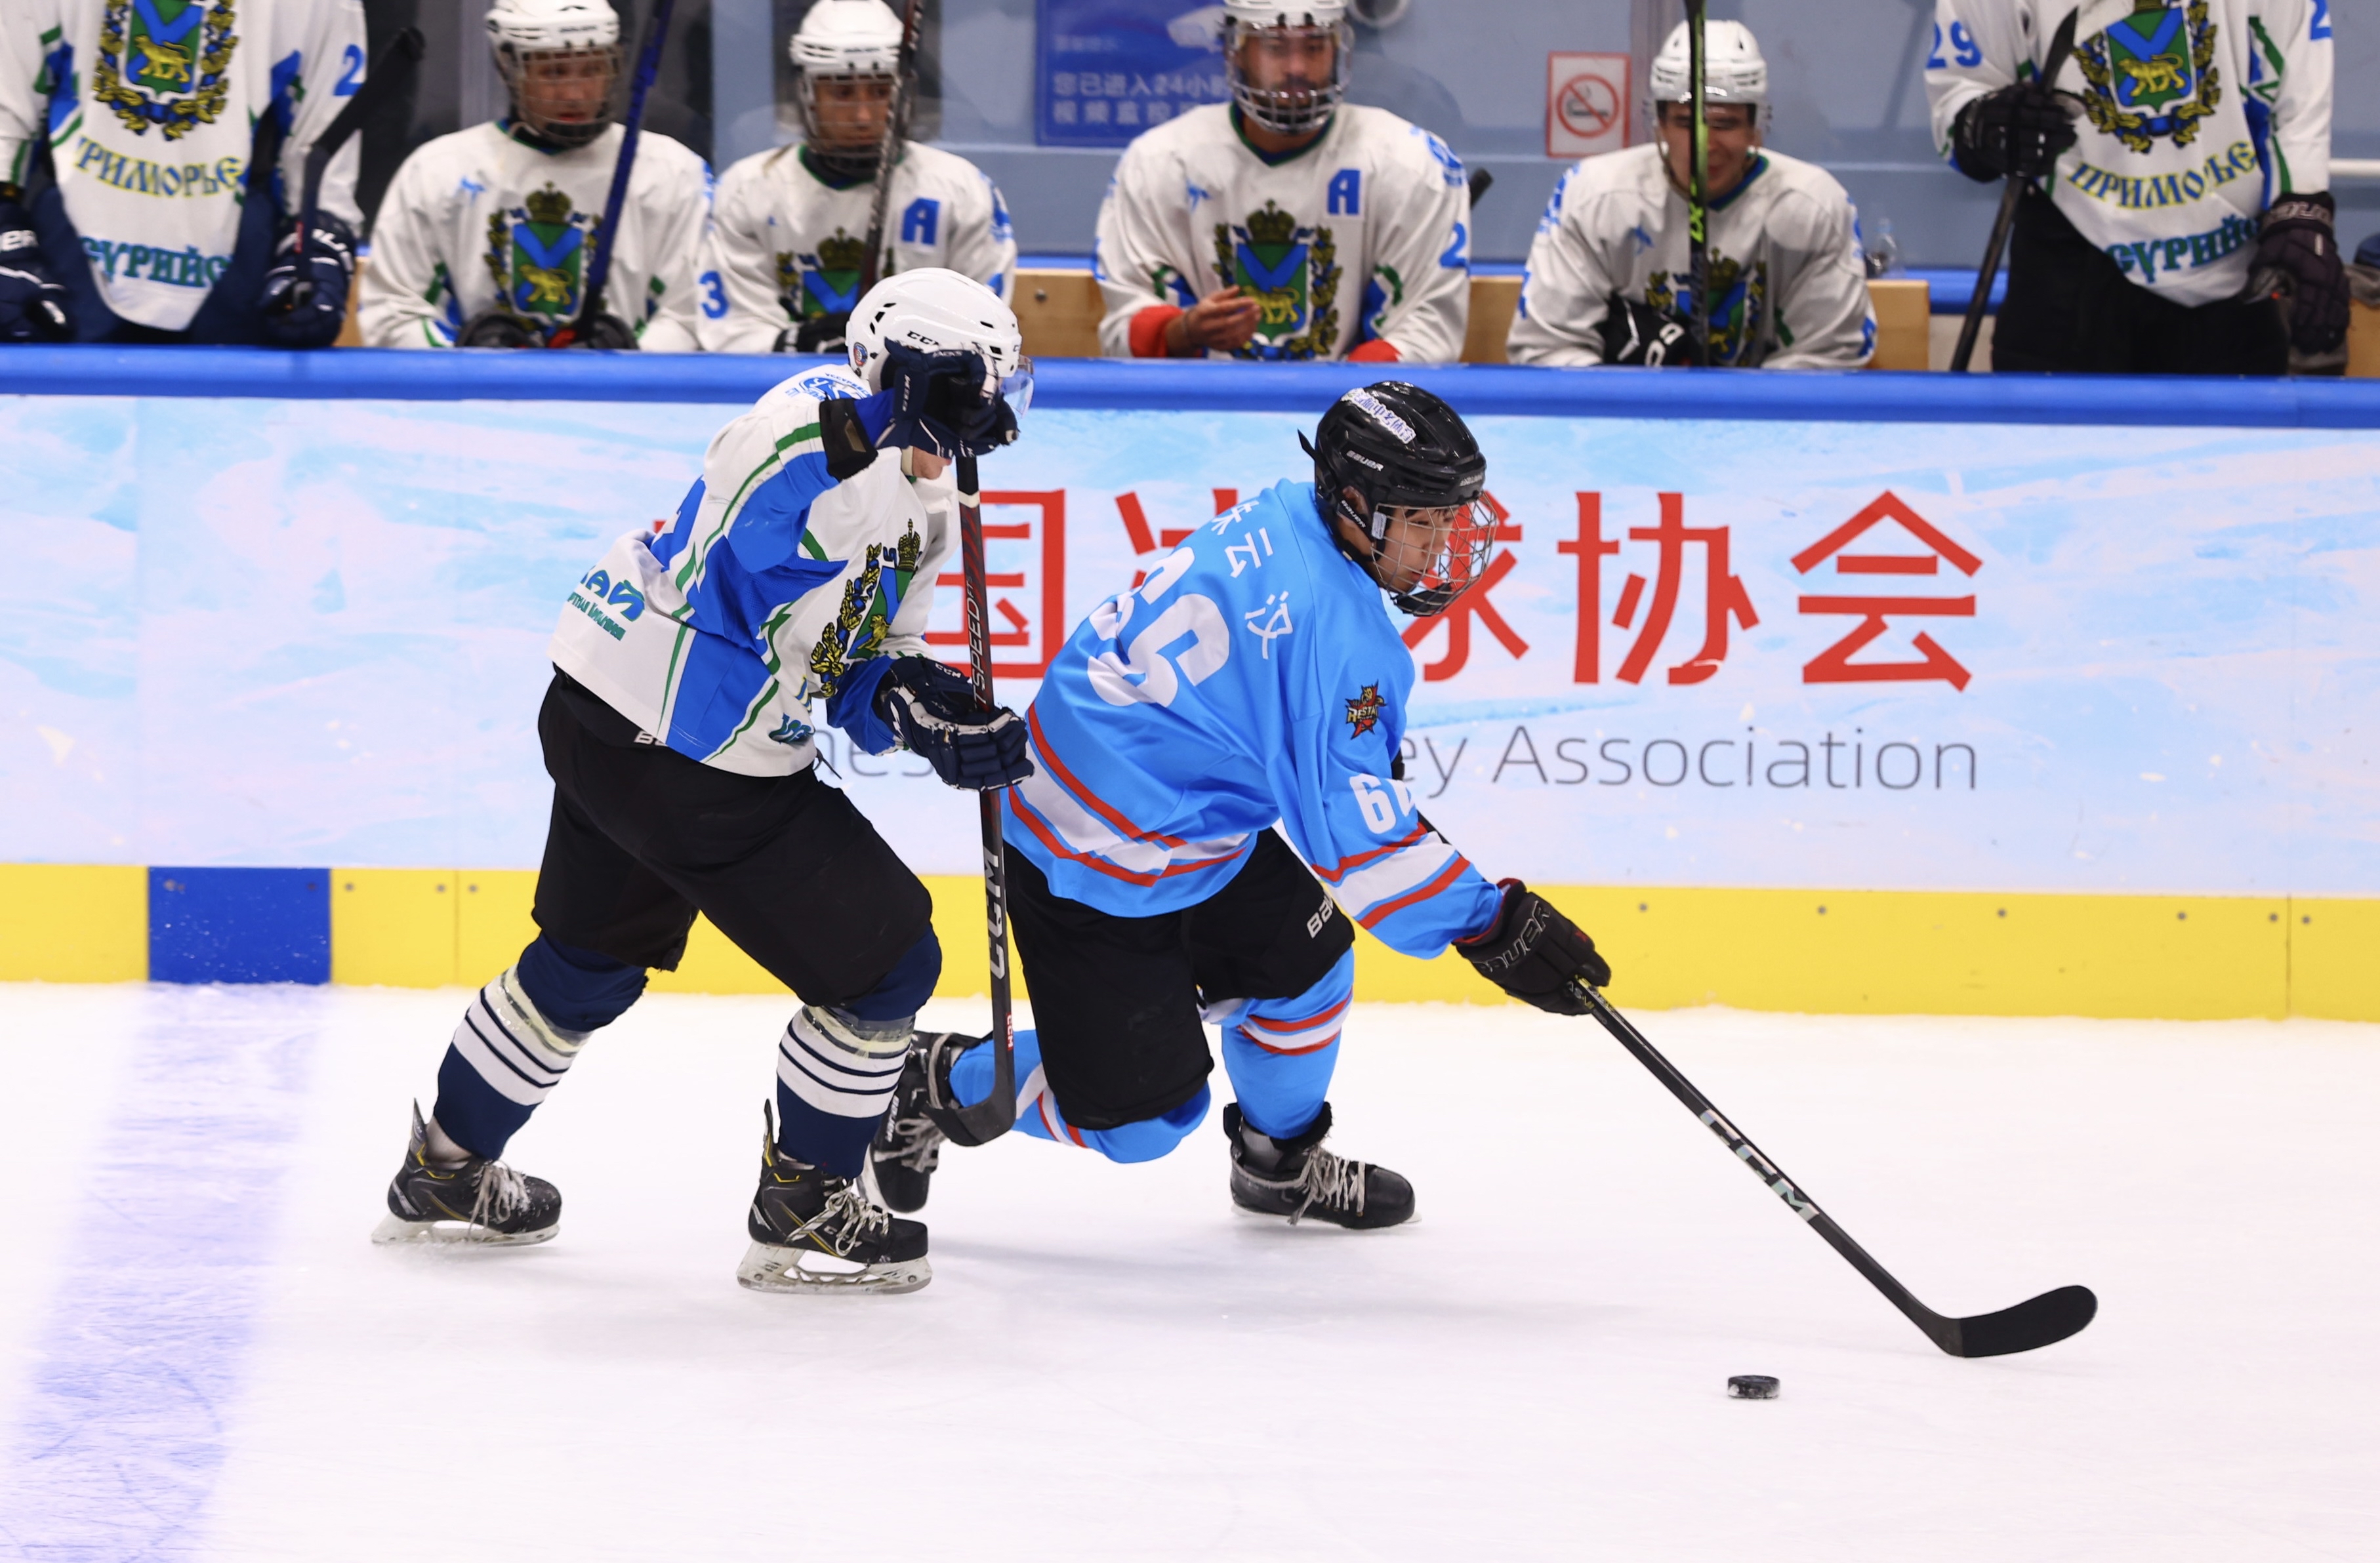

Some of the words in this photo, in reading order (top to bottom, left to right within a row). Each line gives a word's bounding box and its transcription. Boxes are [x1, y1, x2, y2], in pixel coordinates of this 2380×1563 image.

[333, 44, 365, 96] 2
[1926, 20, 1982, 70] 29
[1328, 169, 1361, 216] A
[2066, 140, 2257, 210] ПРИМОЬЕ
[900, 197, 941, 247] A
[697, 270, 730, 319] 3
[1341, 499, 1366, 529] BAUER
[1086, 546, 1231, 708] 66
[935, 662, 962, 679] CCM
[1492, 724, 1979, 791] Association
[984, 853, 1005, 980] CCM
[1006, 1014, 1014, 1050] CCM
[1700, 1108, 1820, 1221] CCM
